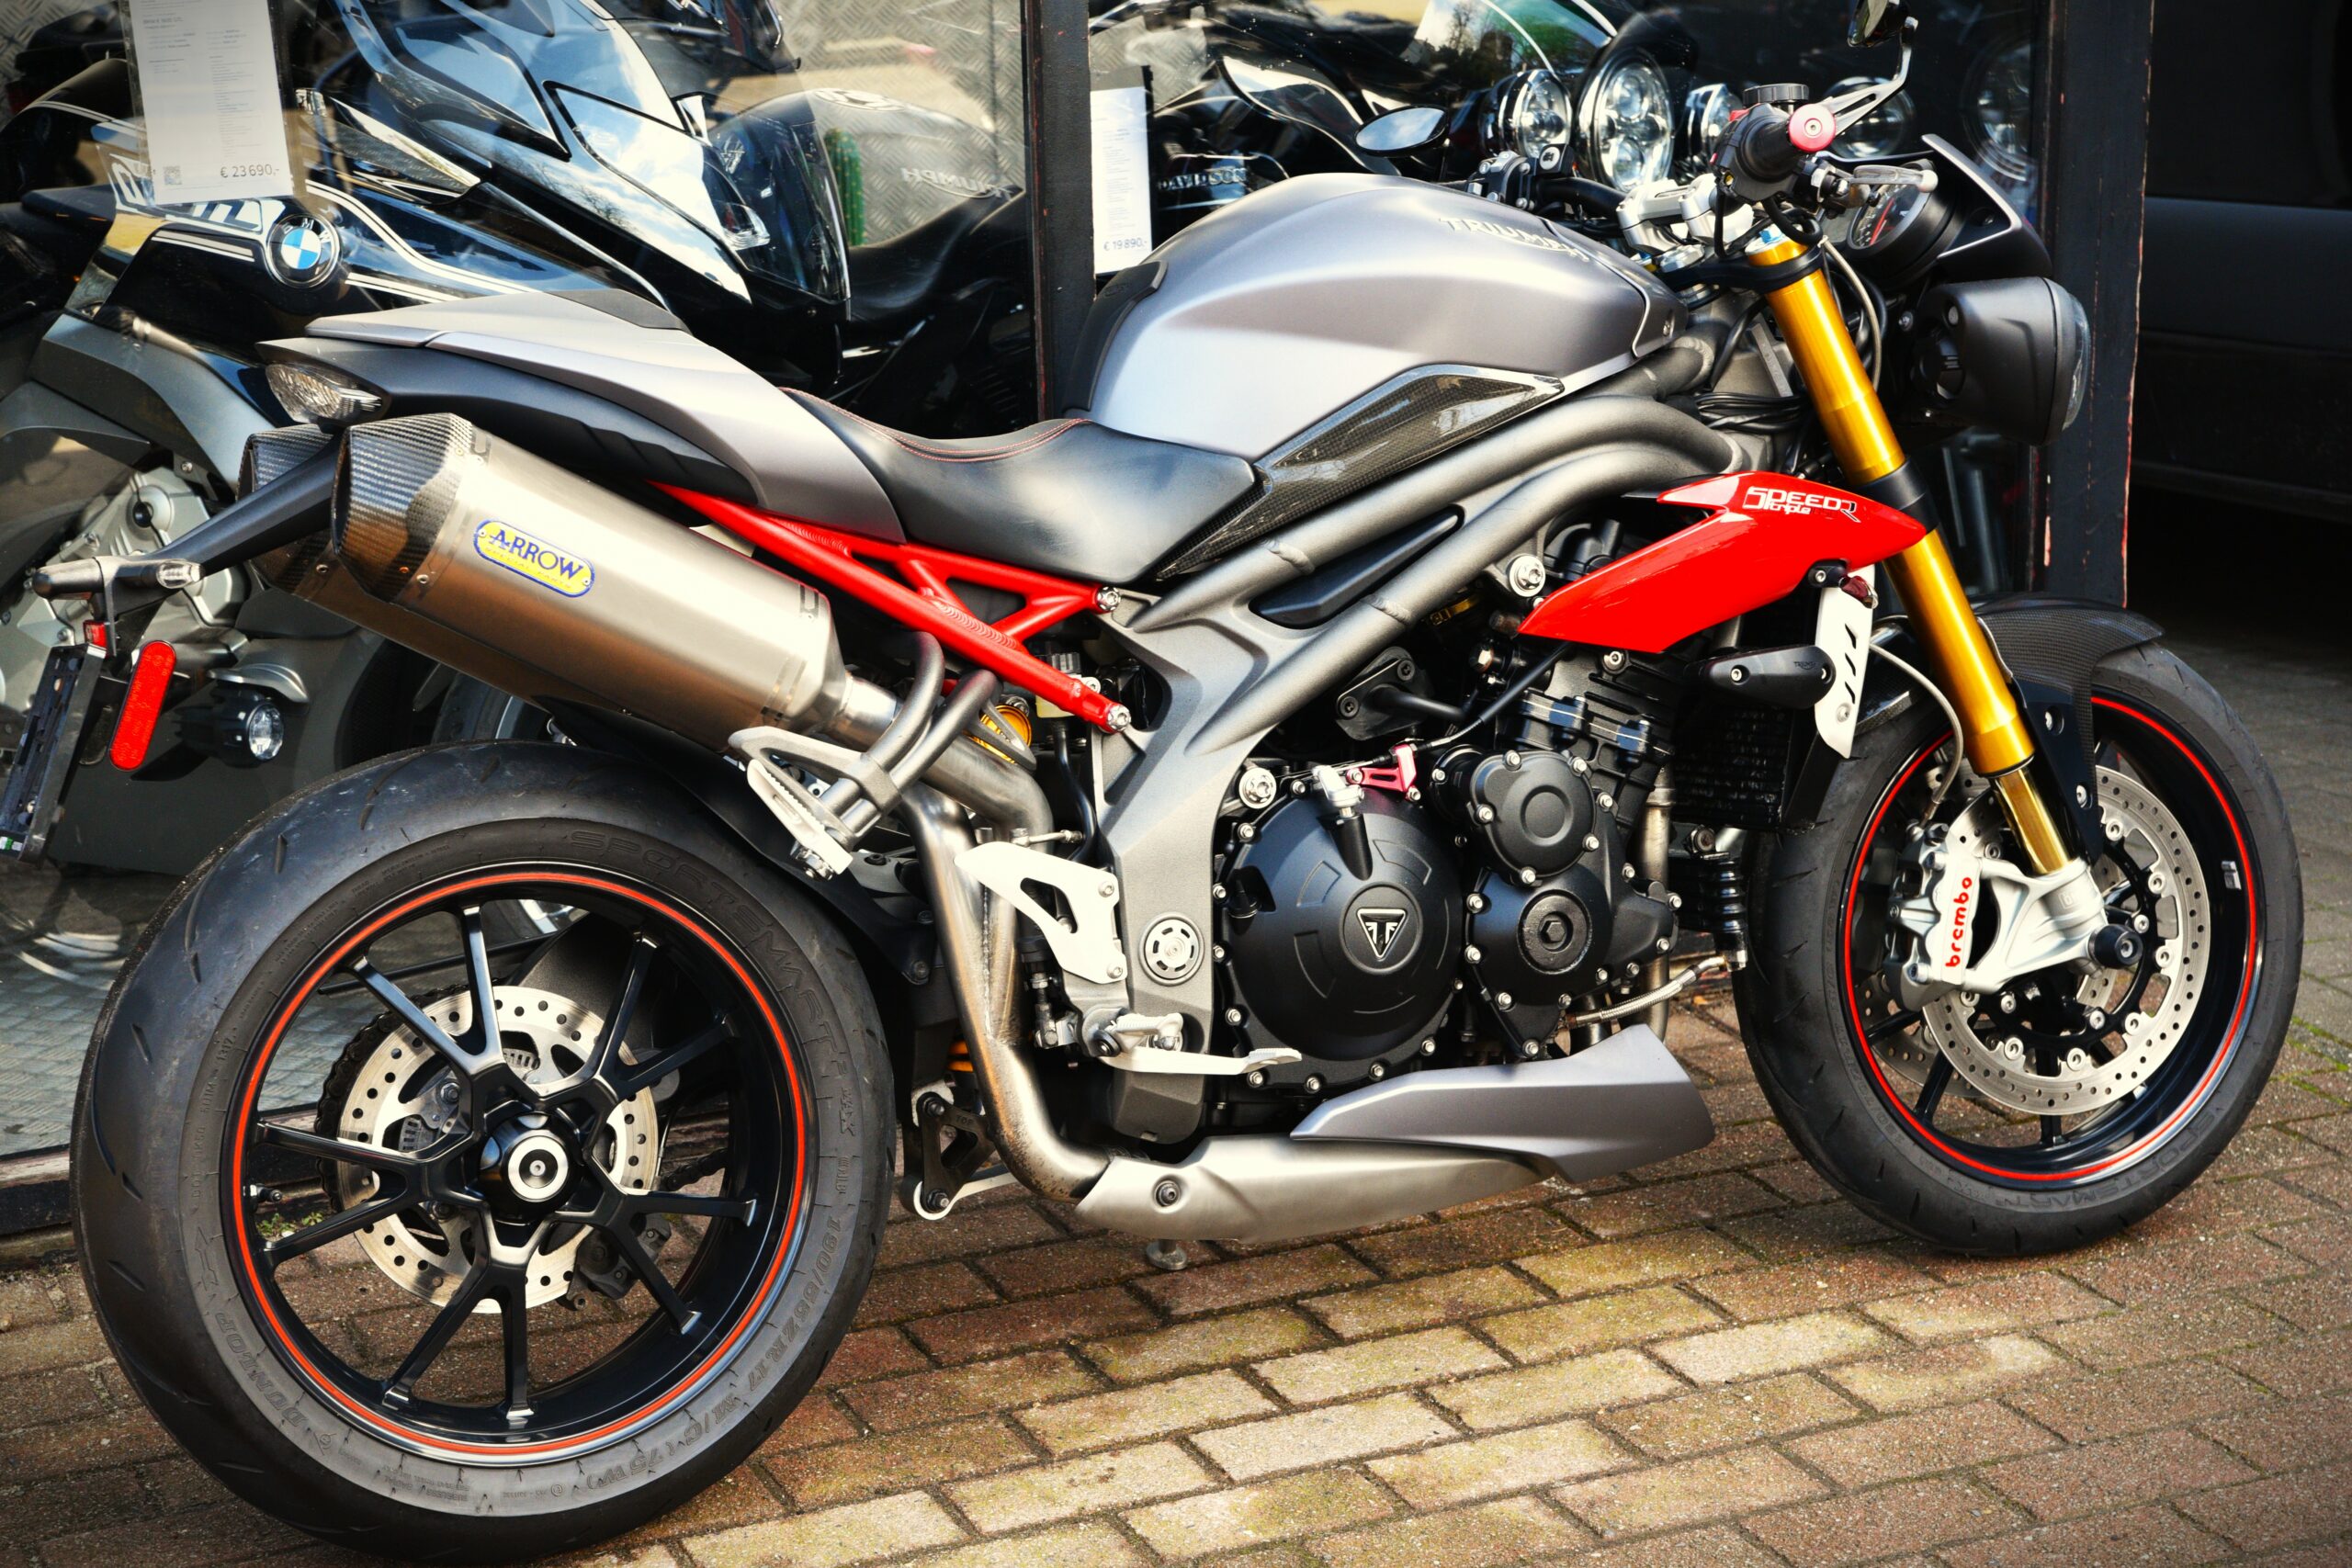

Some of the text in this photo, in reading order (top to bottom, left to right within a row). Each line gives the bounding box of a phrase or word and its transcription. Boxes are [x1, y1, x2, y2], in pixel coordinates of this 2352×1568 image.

[220, 166, 229, 178] €
[1158, 168, 1247, 191] DAVIDSON
[1439, 217, 1590, 263] TRIUMPH
[1742, 485, 1842, 511] SPEED
[489, 529, 583, 580] ARROW
[1945, 876, 1973, 967] brembo
[213, 1307, 308, 1429] DUNLOP
